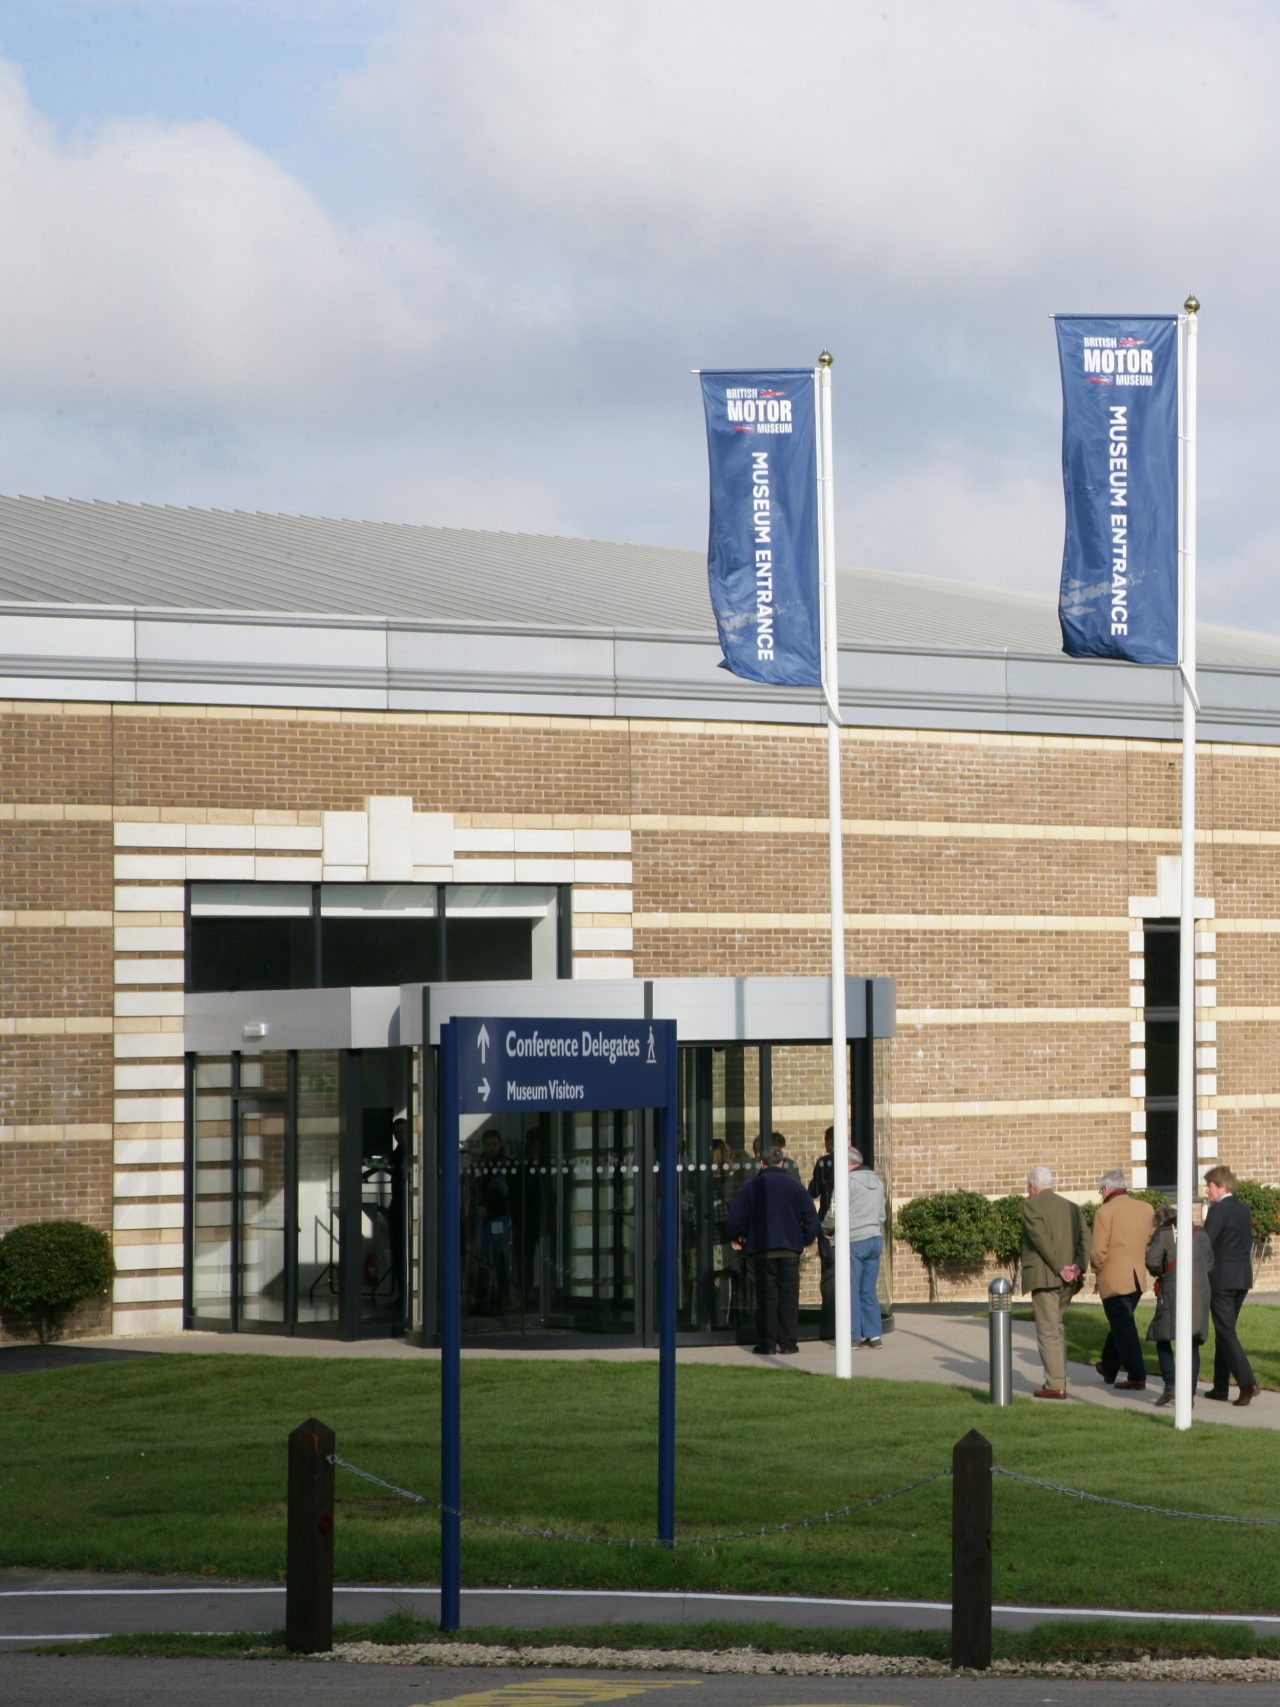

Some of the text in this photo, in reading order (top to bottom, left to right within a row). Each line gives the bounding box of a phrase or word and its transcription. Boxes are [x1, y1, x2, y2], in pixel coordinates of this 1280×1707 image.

[1083, 337, 1117, 348] BRITISH
[1083, 348, 1153, 373] MOTOR
[1115, 374, 1153, 386] MUSEUM
[726, 388, 758, 399] BRITISH
[727, 399, 793, 422] MOTOR
[756, 423, 793, 434] MUSEUM
[1109, 406, 1128, 636] MUSEUM ENTRANCE
[752, 451, 774, 661] MUSEUM ENTRANCE
[505, 1030, 641, 1065] Conference Delegates
[507, 1080, 585, 1101] Museum Visitors
